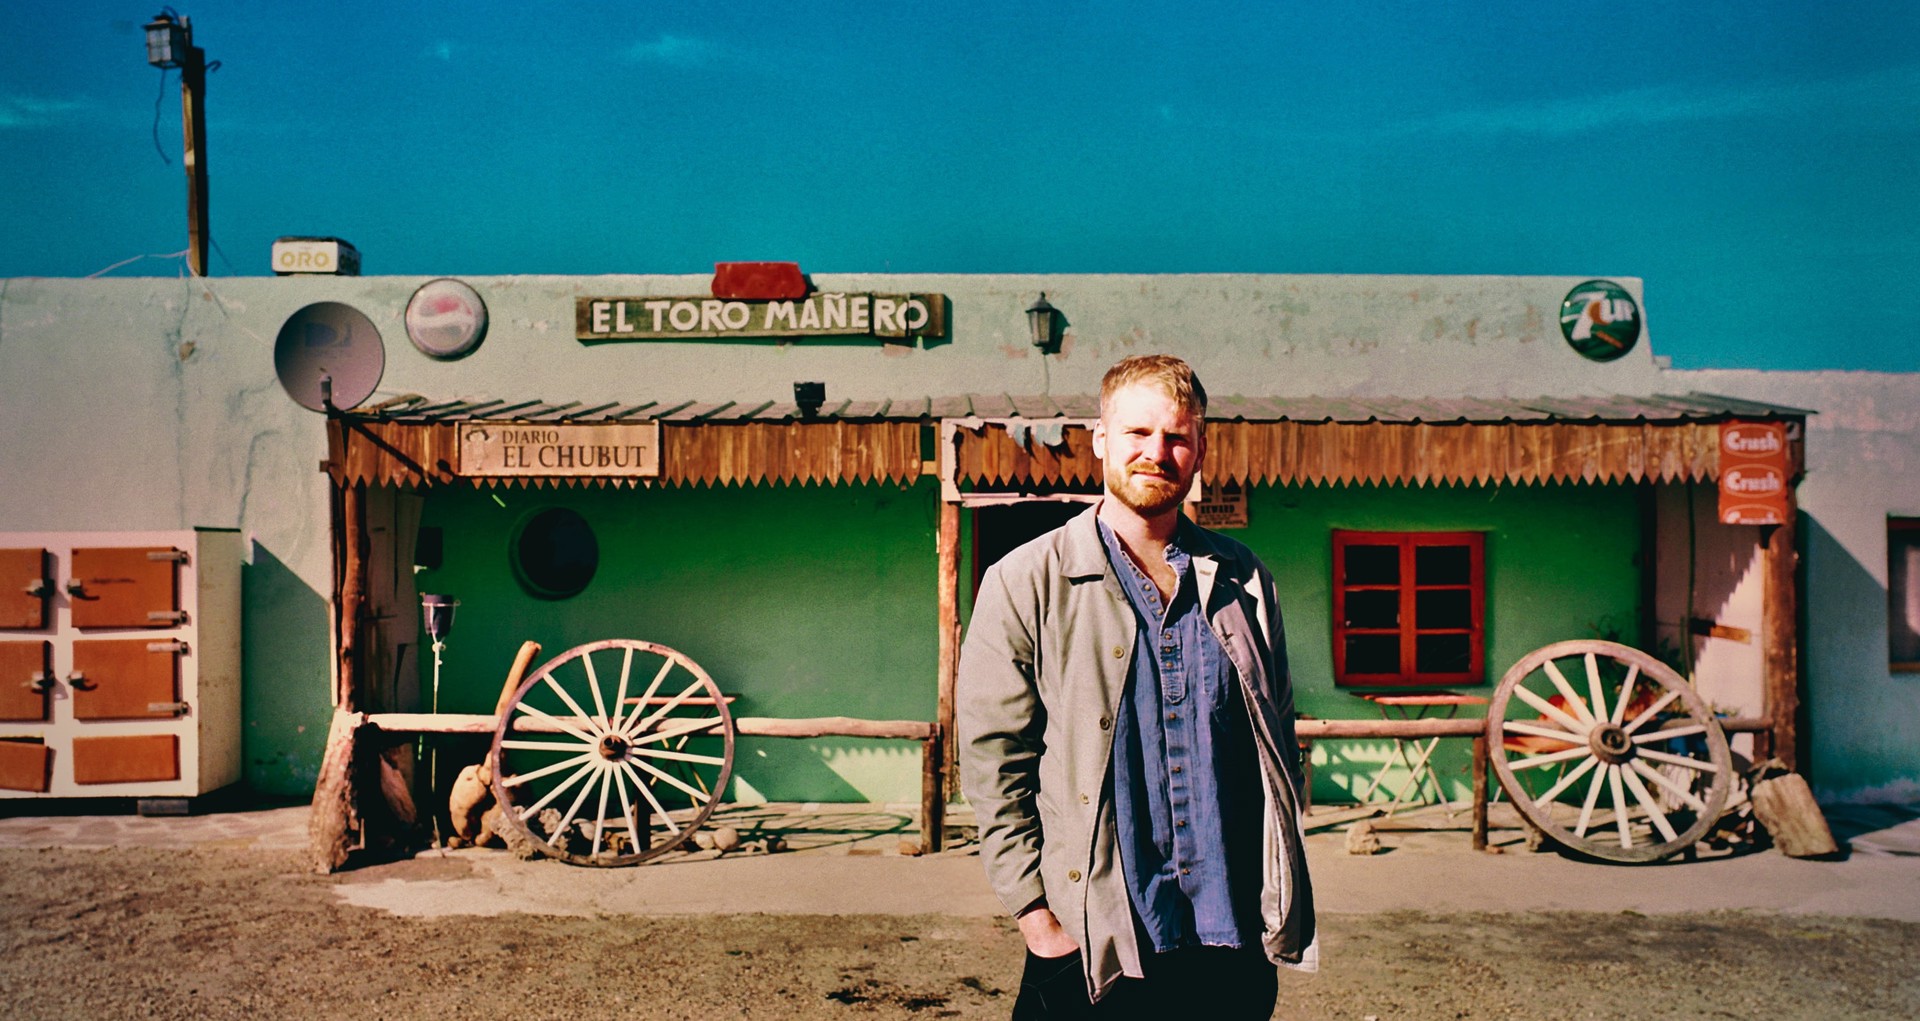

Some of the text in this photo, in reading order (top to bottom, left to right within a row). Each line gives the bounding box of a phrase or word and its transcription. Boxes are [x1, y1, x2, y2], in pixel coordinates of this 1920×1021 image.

[280, 251, 330, 268] ORO
[592, 293, 929, 333] EL TORO MAÑERO
[502, 430, 559, 444] DIARIO
[1725, 431, 1780, 451] Crush
[503, 445, 647, 468] EL CHUBUT
[1726, 471, 1781, 491] Crush
